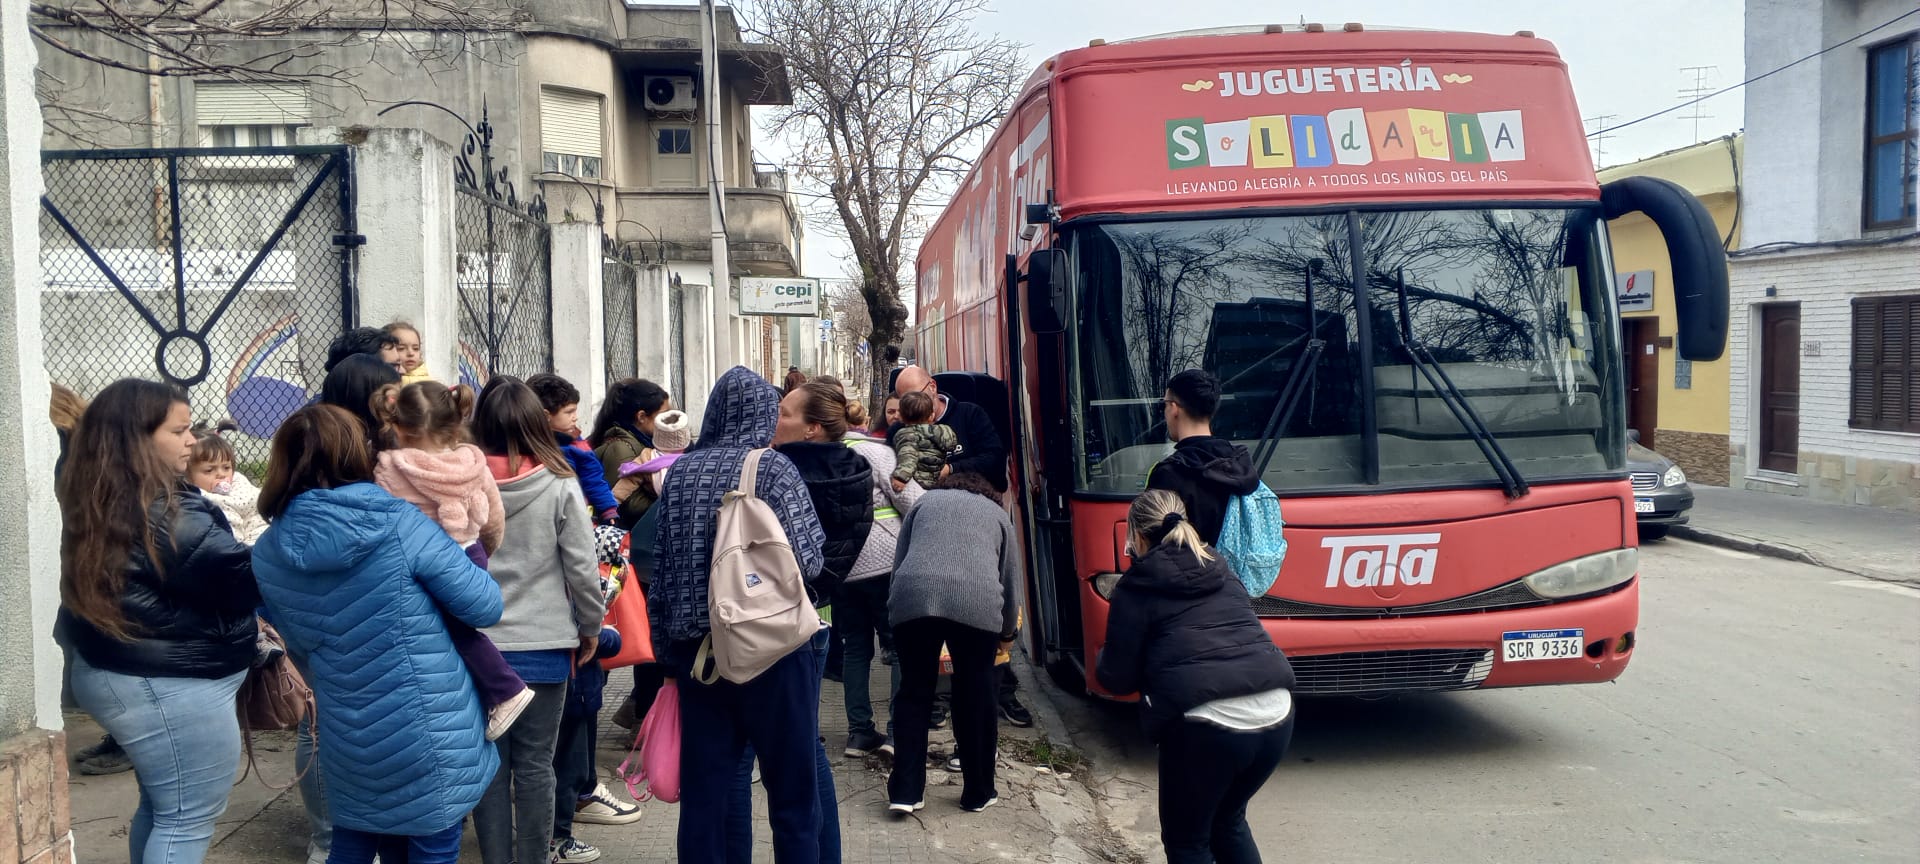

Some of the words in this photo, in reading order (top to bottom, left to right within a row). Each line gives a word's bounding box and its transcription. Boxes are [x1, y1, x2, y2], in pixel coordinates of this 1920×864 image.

[1218, 58, 1442, 97] JUGUETERÍA
[1166, 180, 1238, 195] LLEVANDO
[1244, 173, 1302, 190] ALEGRÍA
[1308, 176, 1317, 187] A
[1321, 174, 1369, 187] TODOS
[1374, 172, 1401, 185] LOS
[1405, 168, 1446, 184] NIÑOS
[1451, 170, 1476, 183] DEL
[1480, 167, 1509, 182] PAÍS
[774, 283, 812, 298] cepi
[1321, 533, 1442, 588] TaTa
[1527, 631, 1558, 639] URUGUAY
[1508, 641, 1534, 659] SCR
[1542, 640, 1578, 657] 9336
